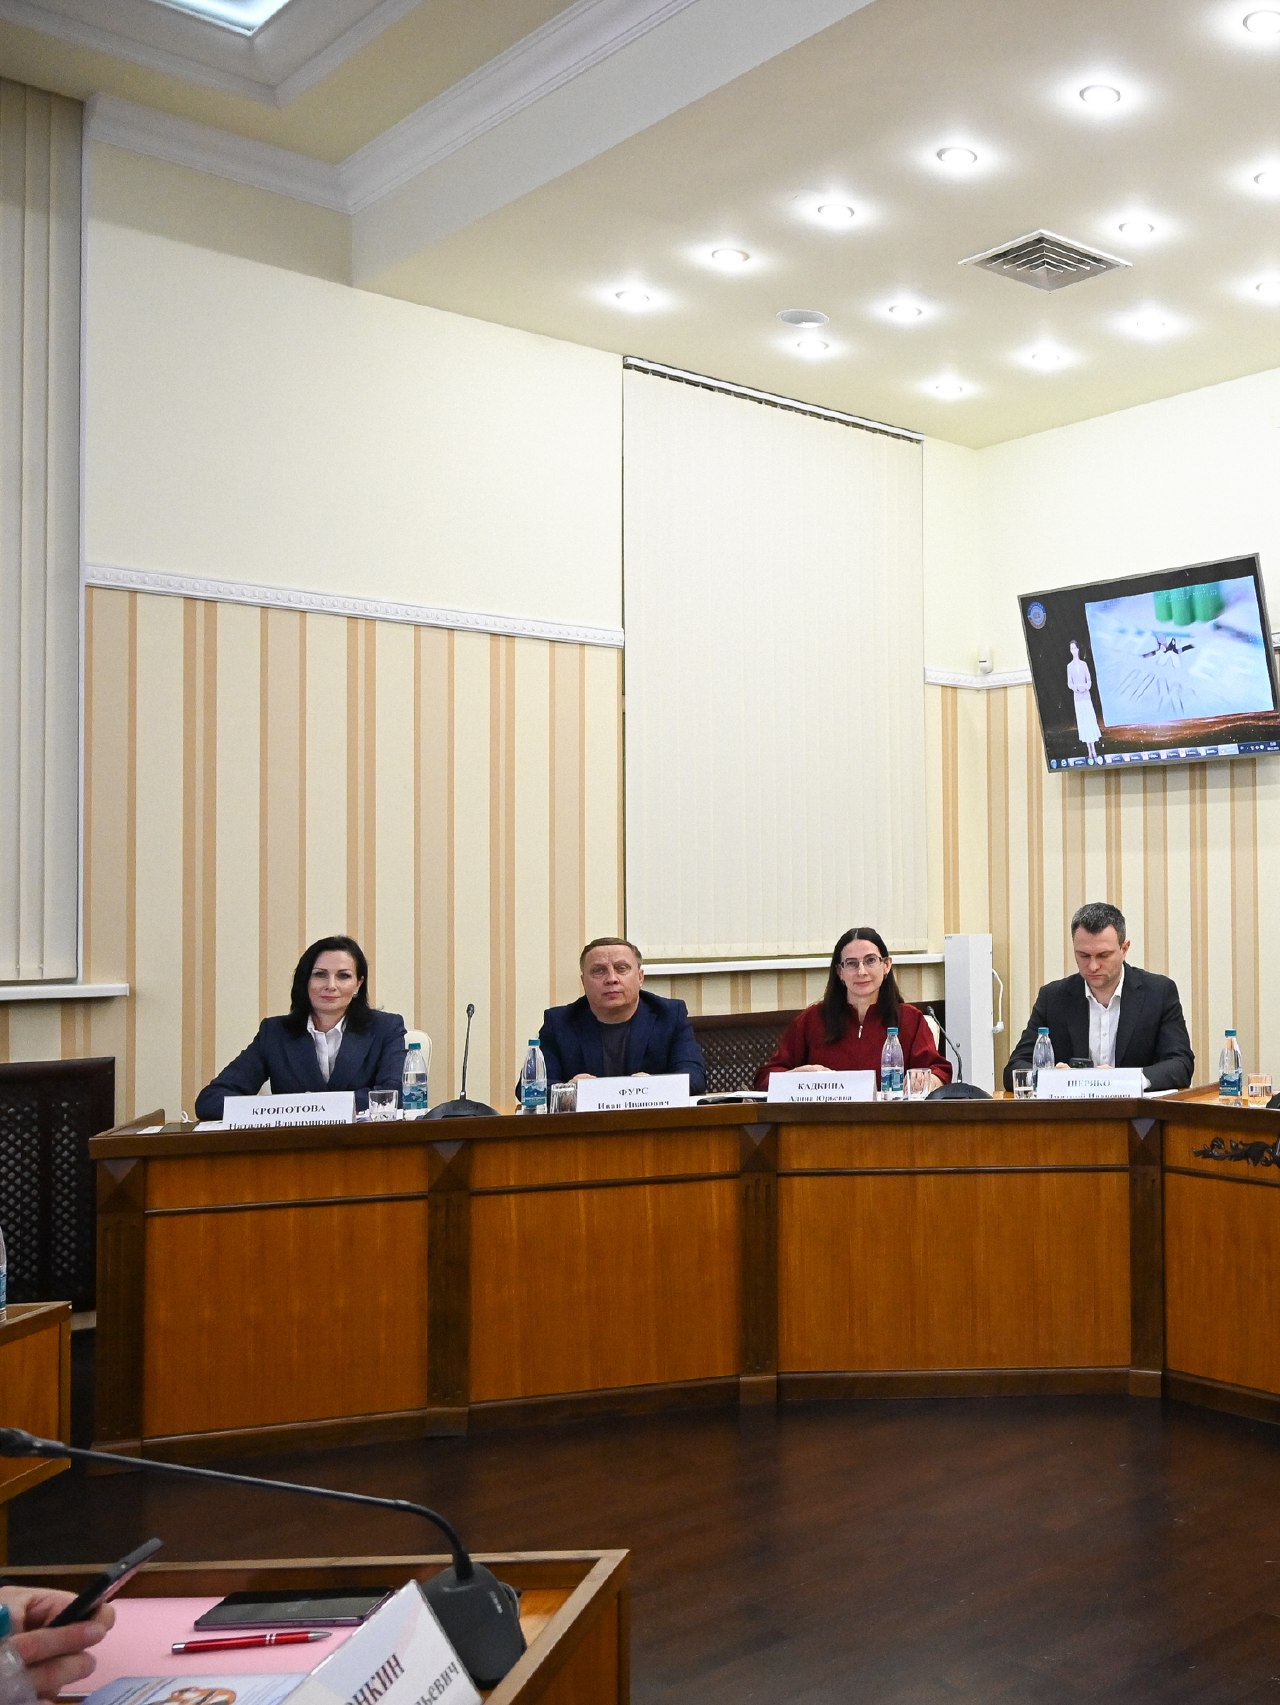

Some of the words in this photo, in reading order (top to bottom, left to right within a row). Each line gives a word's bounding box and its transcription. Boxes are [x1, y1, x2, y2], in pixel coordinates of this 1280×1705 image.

[618, 1087, 649, 1096] ФУРС
[798, 1082, 845, 1090] КАДКИНА
[252, 1104, 326, 1116] КРОПОТОВА
[597, 1102, 621, 1110] Иван
[624, 1100, 669, 1108] Иванович
[344, 1653, 406, 1705] НКИН
[415, 1661, 460, 1705] ьевич
